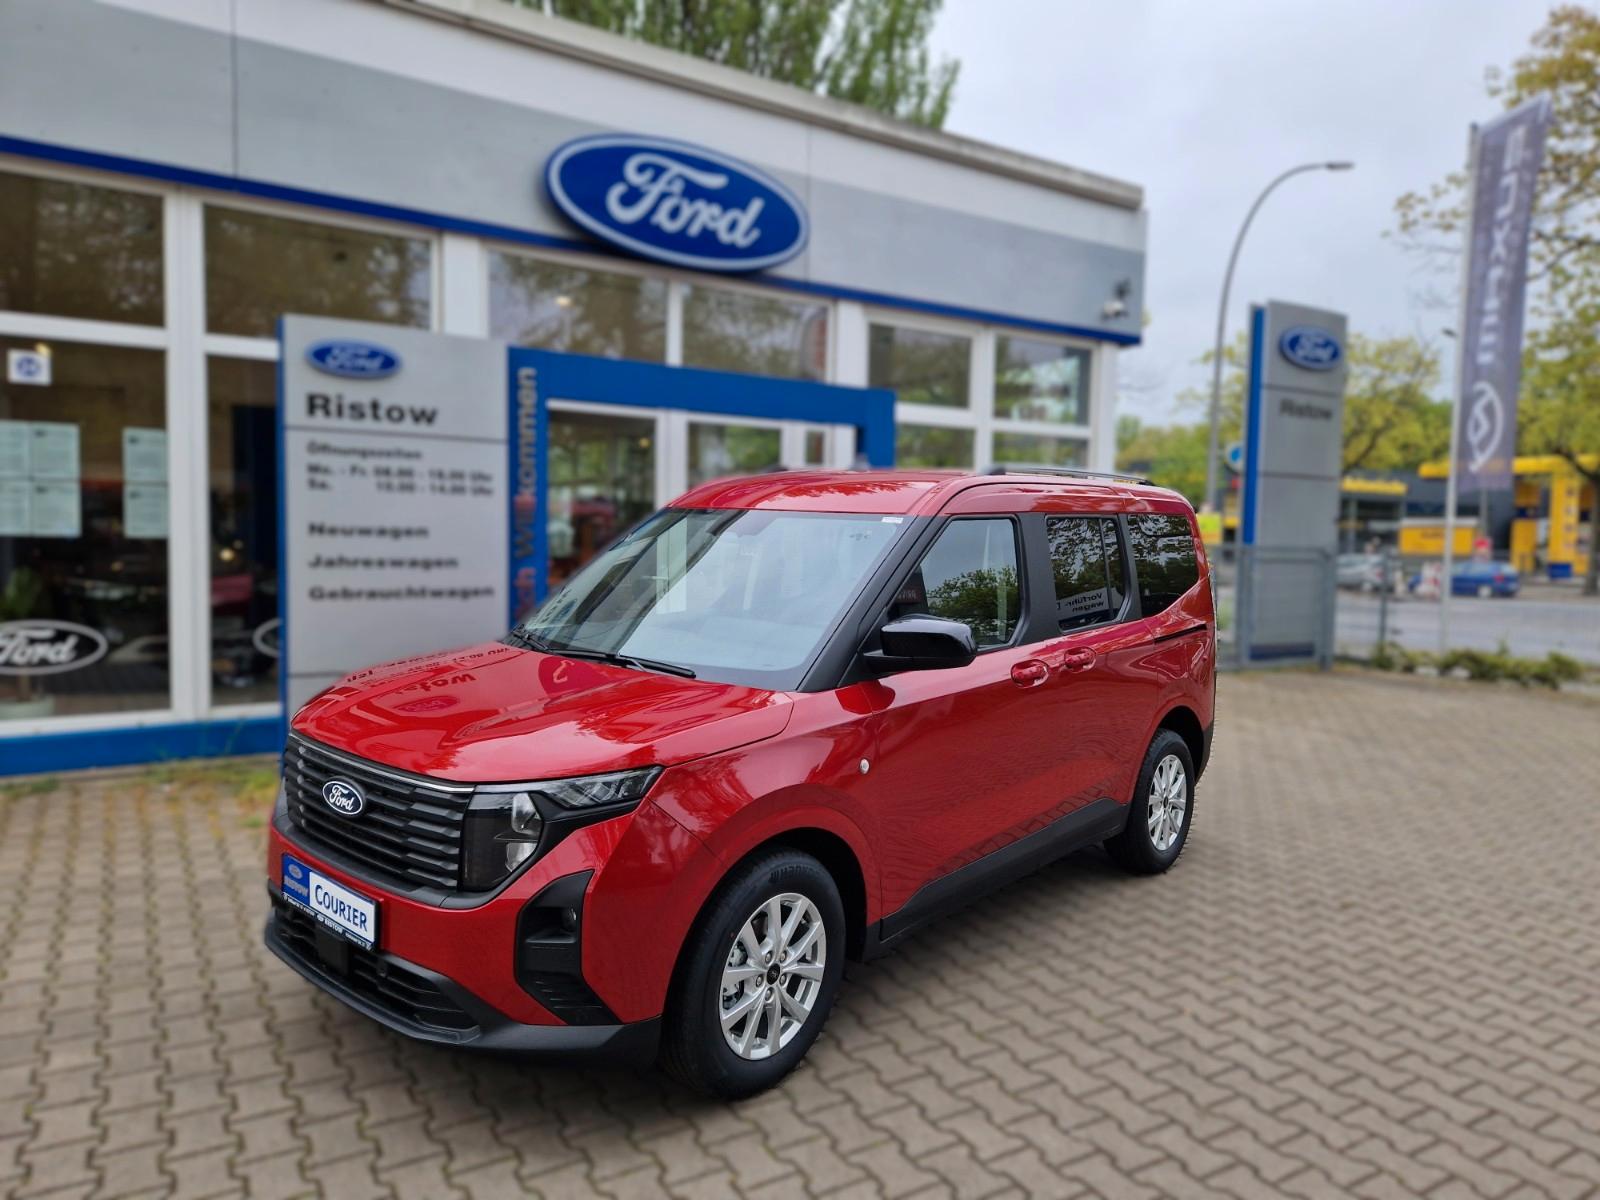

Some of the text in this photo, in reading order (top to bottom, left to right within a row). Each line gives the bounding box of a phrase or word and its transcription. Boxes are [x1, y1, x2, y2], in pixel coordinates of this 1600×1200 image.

[605, 152, 766, 248] Ford
[323, 345, 386, 373] Ford
[306, 393, 438, 426] Ristow
[308, 522, 429, 539] Neuwagen
[308, 555, 459, 571] Jahreswagen
[308, 584, 495, 602] Gebrauchtwagen
[0, 629, 79, 666] Ford
[328, 784, 356, 811] Ford
[314, 883, 368, 932] COURIER
